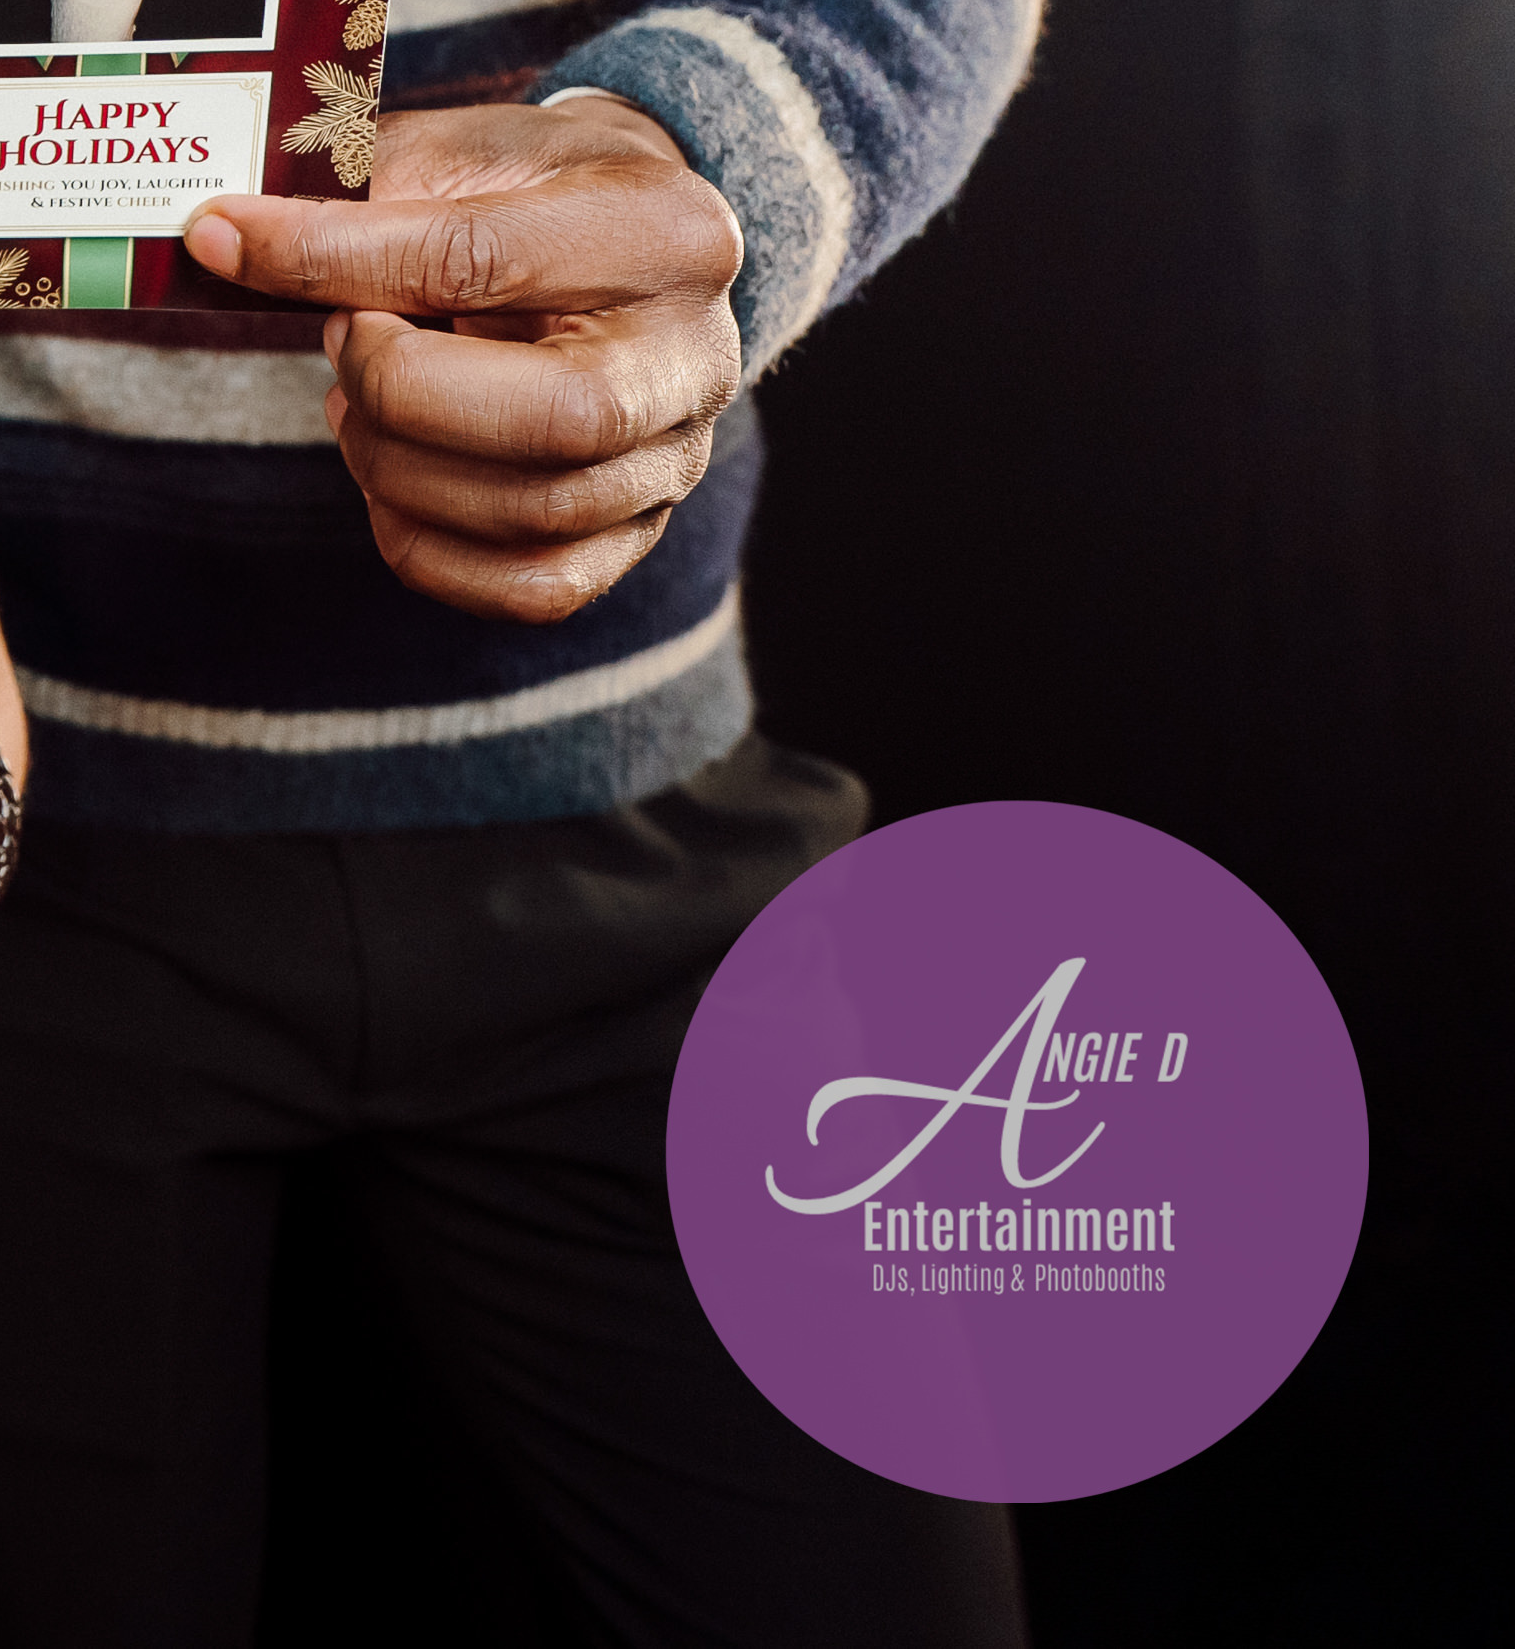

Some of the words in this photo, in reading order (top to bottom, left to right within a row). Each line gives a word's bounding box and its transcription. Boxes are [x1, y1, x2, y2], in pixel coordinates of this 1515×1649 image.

[33, 99, 180, 136] HAPPY
[62, 180, 95, 190] YOU
[99, 179, 131, 191] JOY,
[136, 178, 224, 190] LAUGHTER
[30, 197, 44, 208] &
[50, 197, 112, 208] FESTIVE
[117, 196, 171, 207] CHEER
